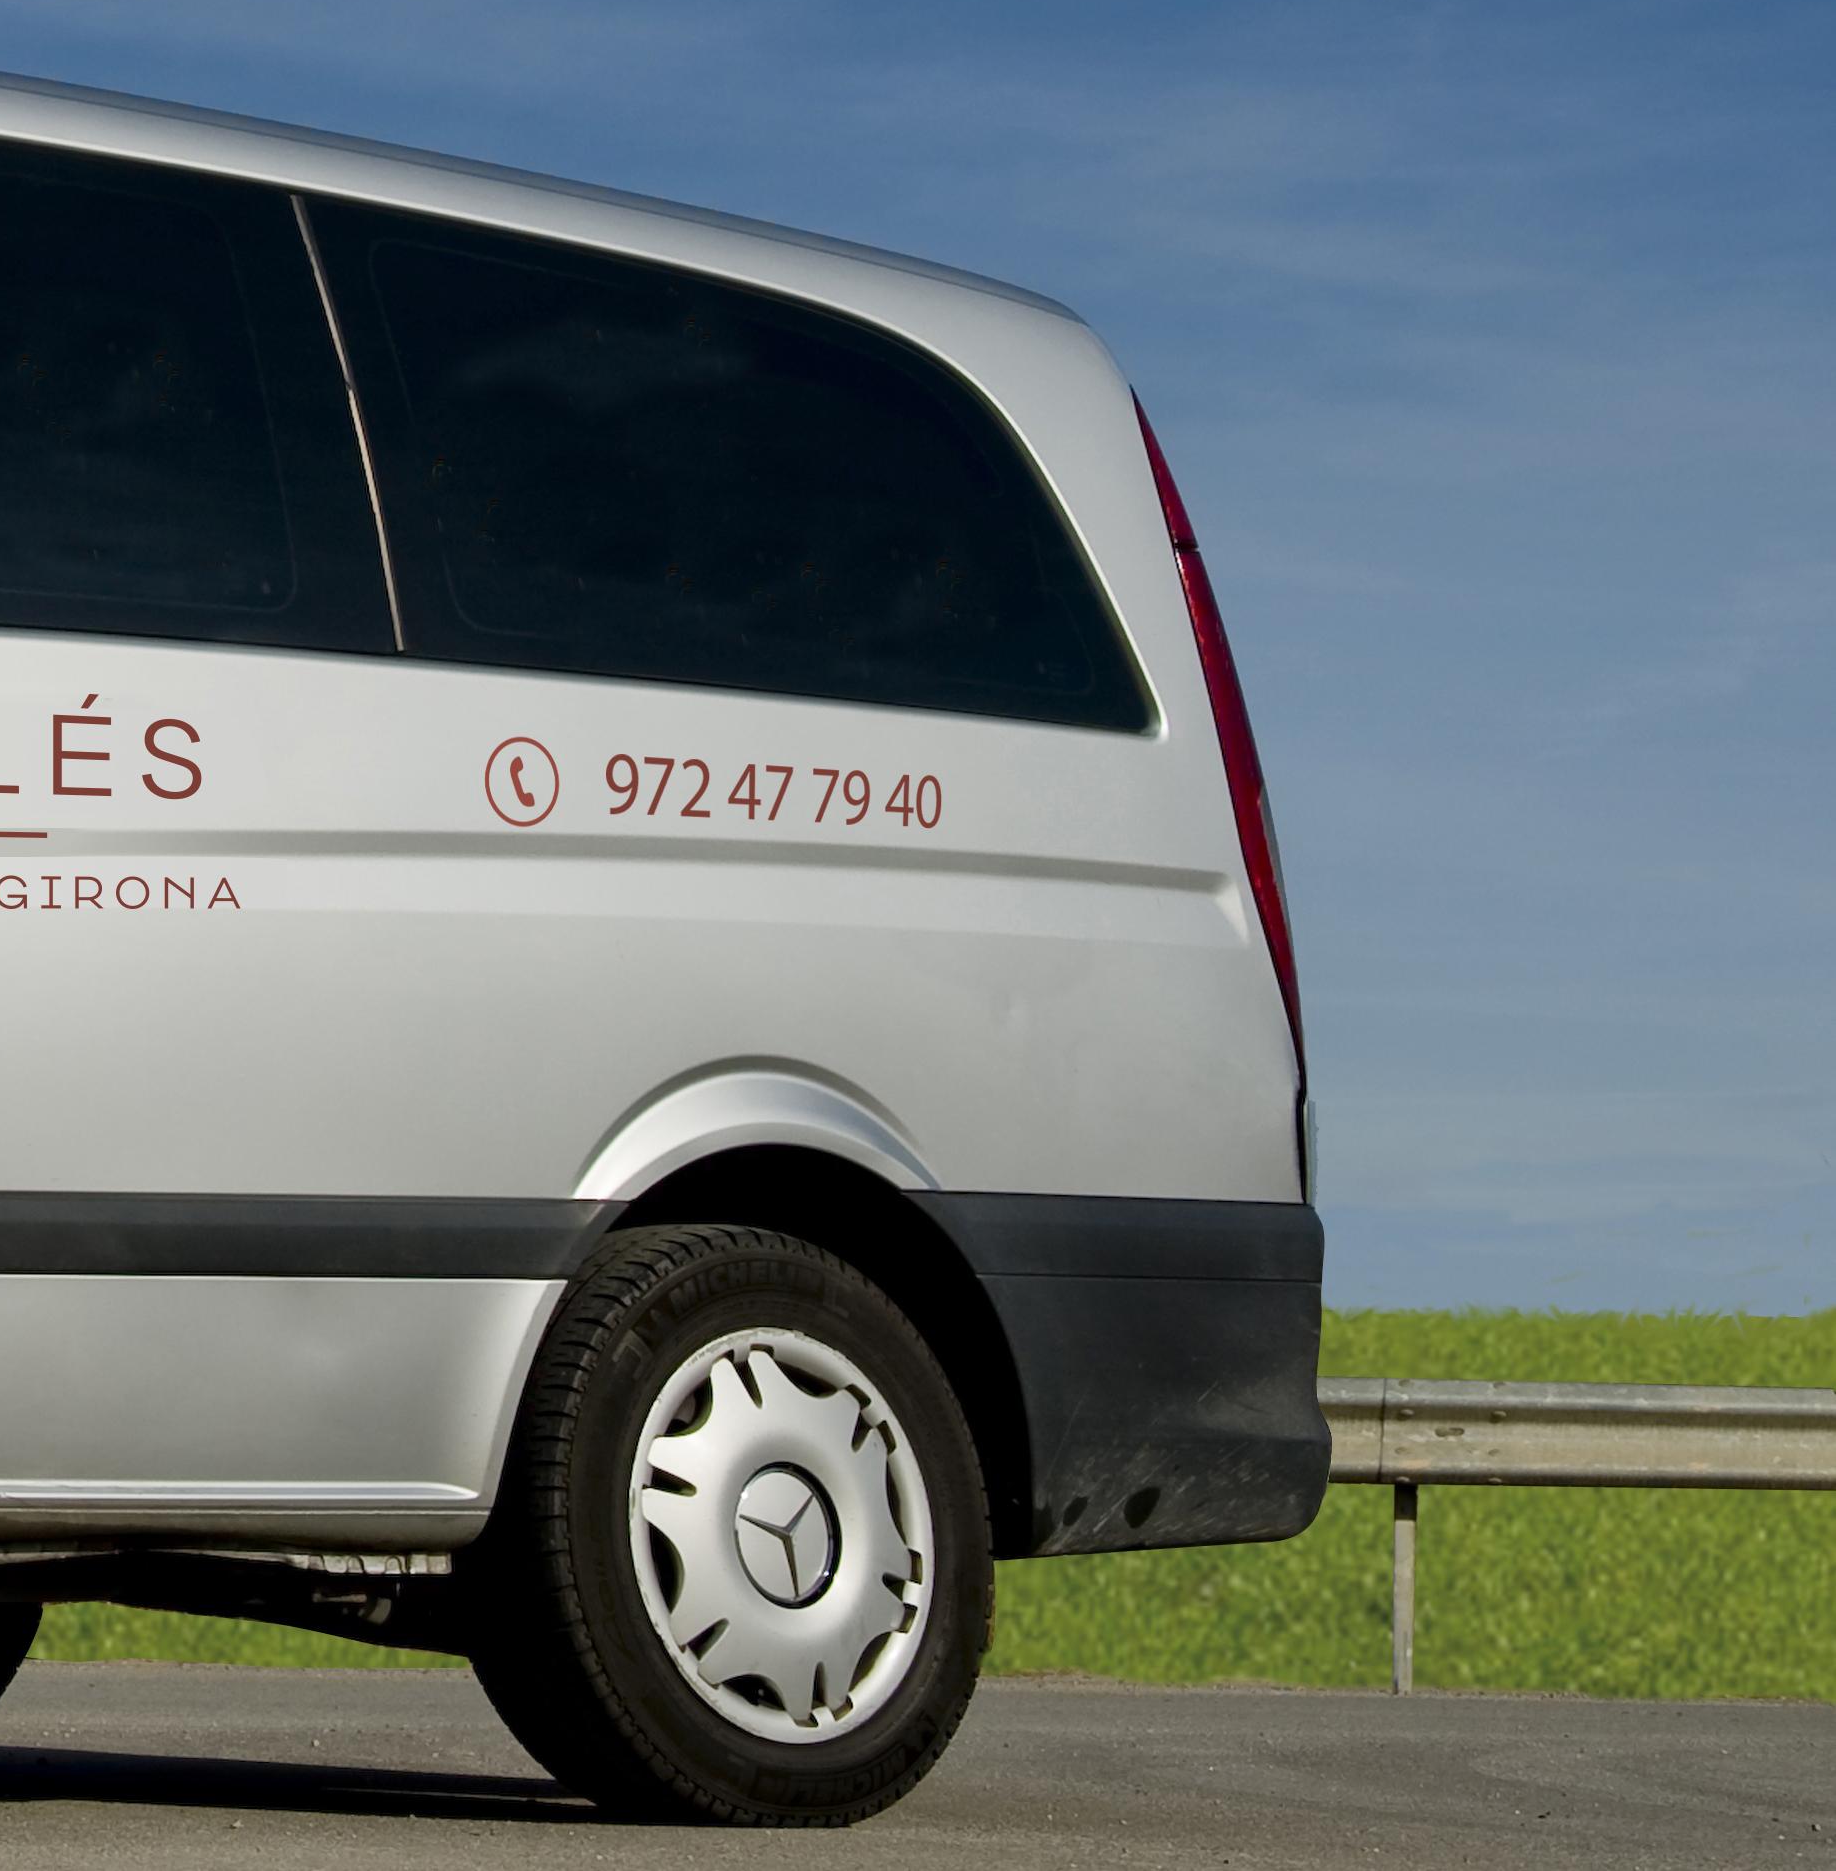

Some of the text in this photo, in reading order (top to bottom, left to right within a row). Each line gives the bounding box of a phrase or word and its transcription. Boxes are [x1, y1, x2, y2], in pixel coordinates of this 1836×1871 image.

[605, 753, 942, 829] 972 47 79 40
[672, 1259, 825, 1317] MICHELIN
